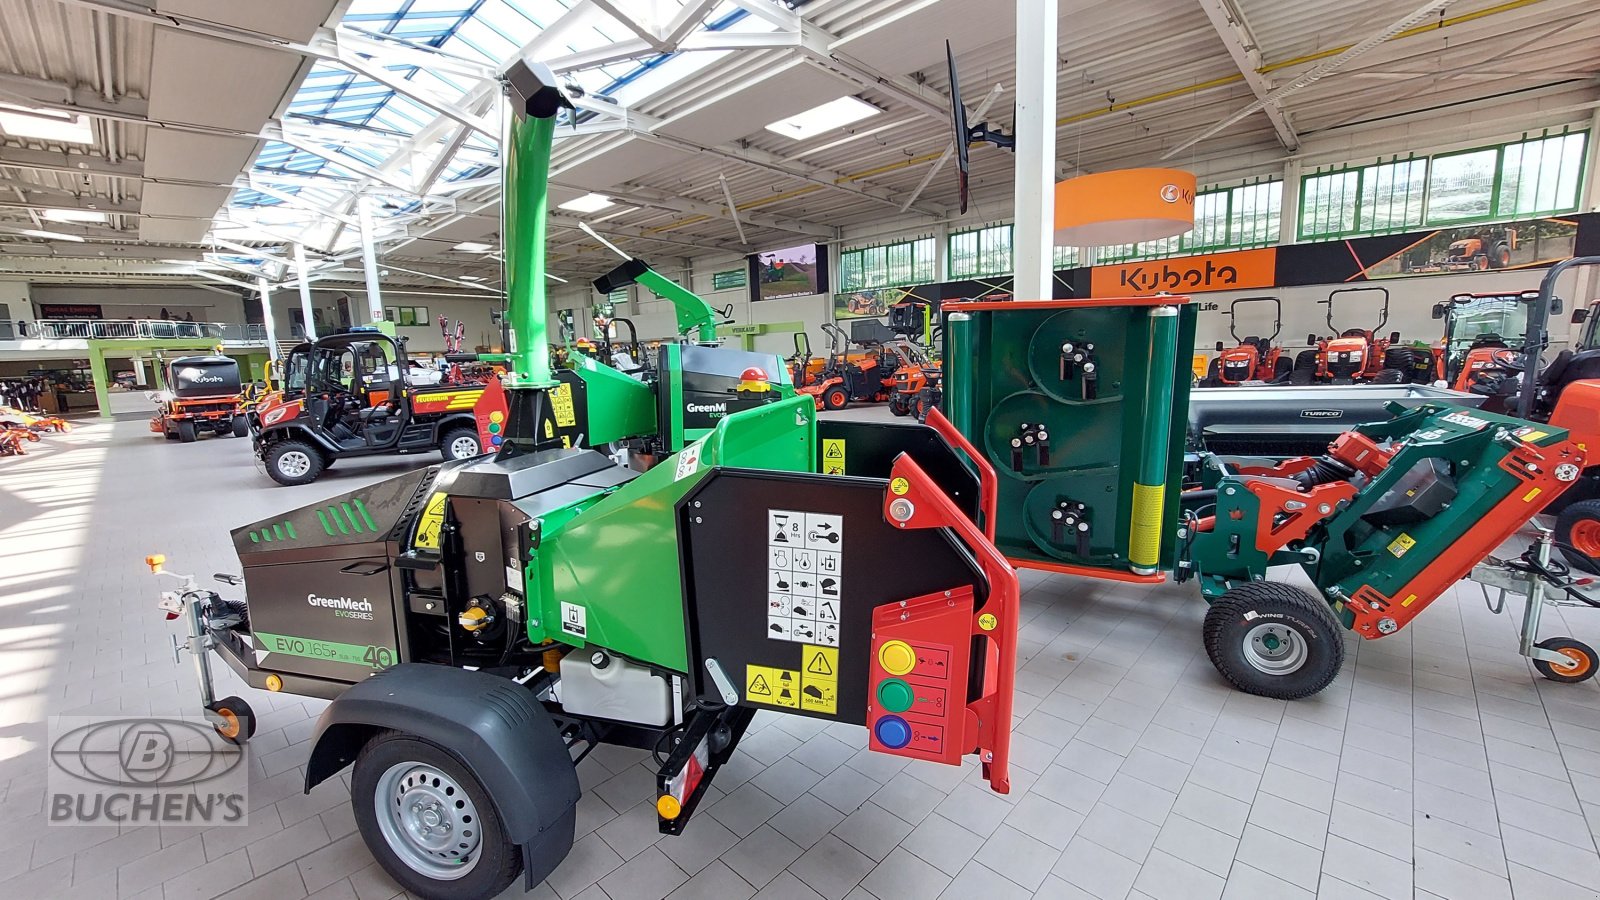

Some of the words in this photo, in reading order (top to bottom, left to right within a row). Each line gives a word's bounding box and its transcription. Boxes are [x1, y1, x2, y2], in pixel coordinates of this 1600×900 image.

[1120, 260, 1237, 292] Kubota
[1199, 302, 1219, 312] Life
[191, 375, 224, 383] Kubota
[416, 396, 449, 404] FEUERWEHR
[686, 402, 727, 413] GreenM
[792, 522, 799, 532] 8
[307, 593, 373, 612] GreenMech
[335, 609, 374, 621] EVOSERIES
[276, 637, 305, 654] EVO
[362, 645, 393, 669] 40
